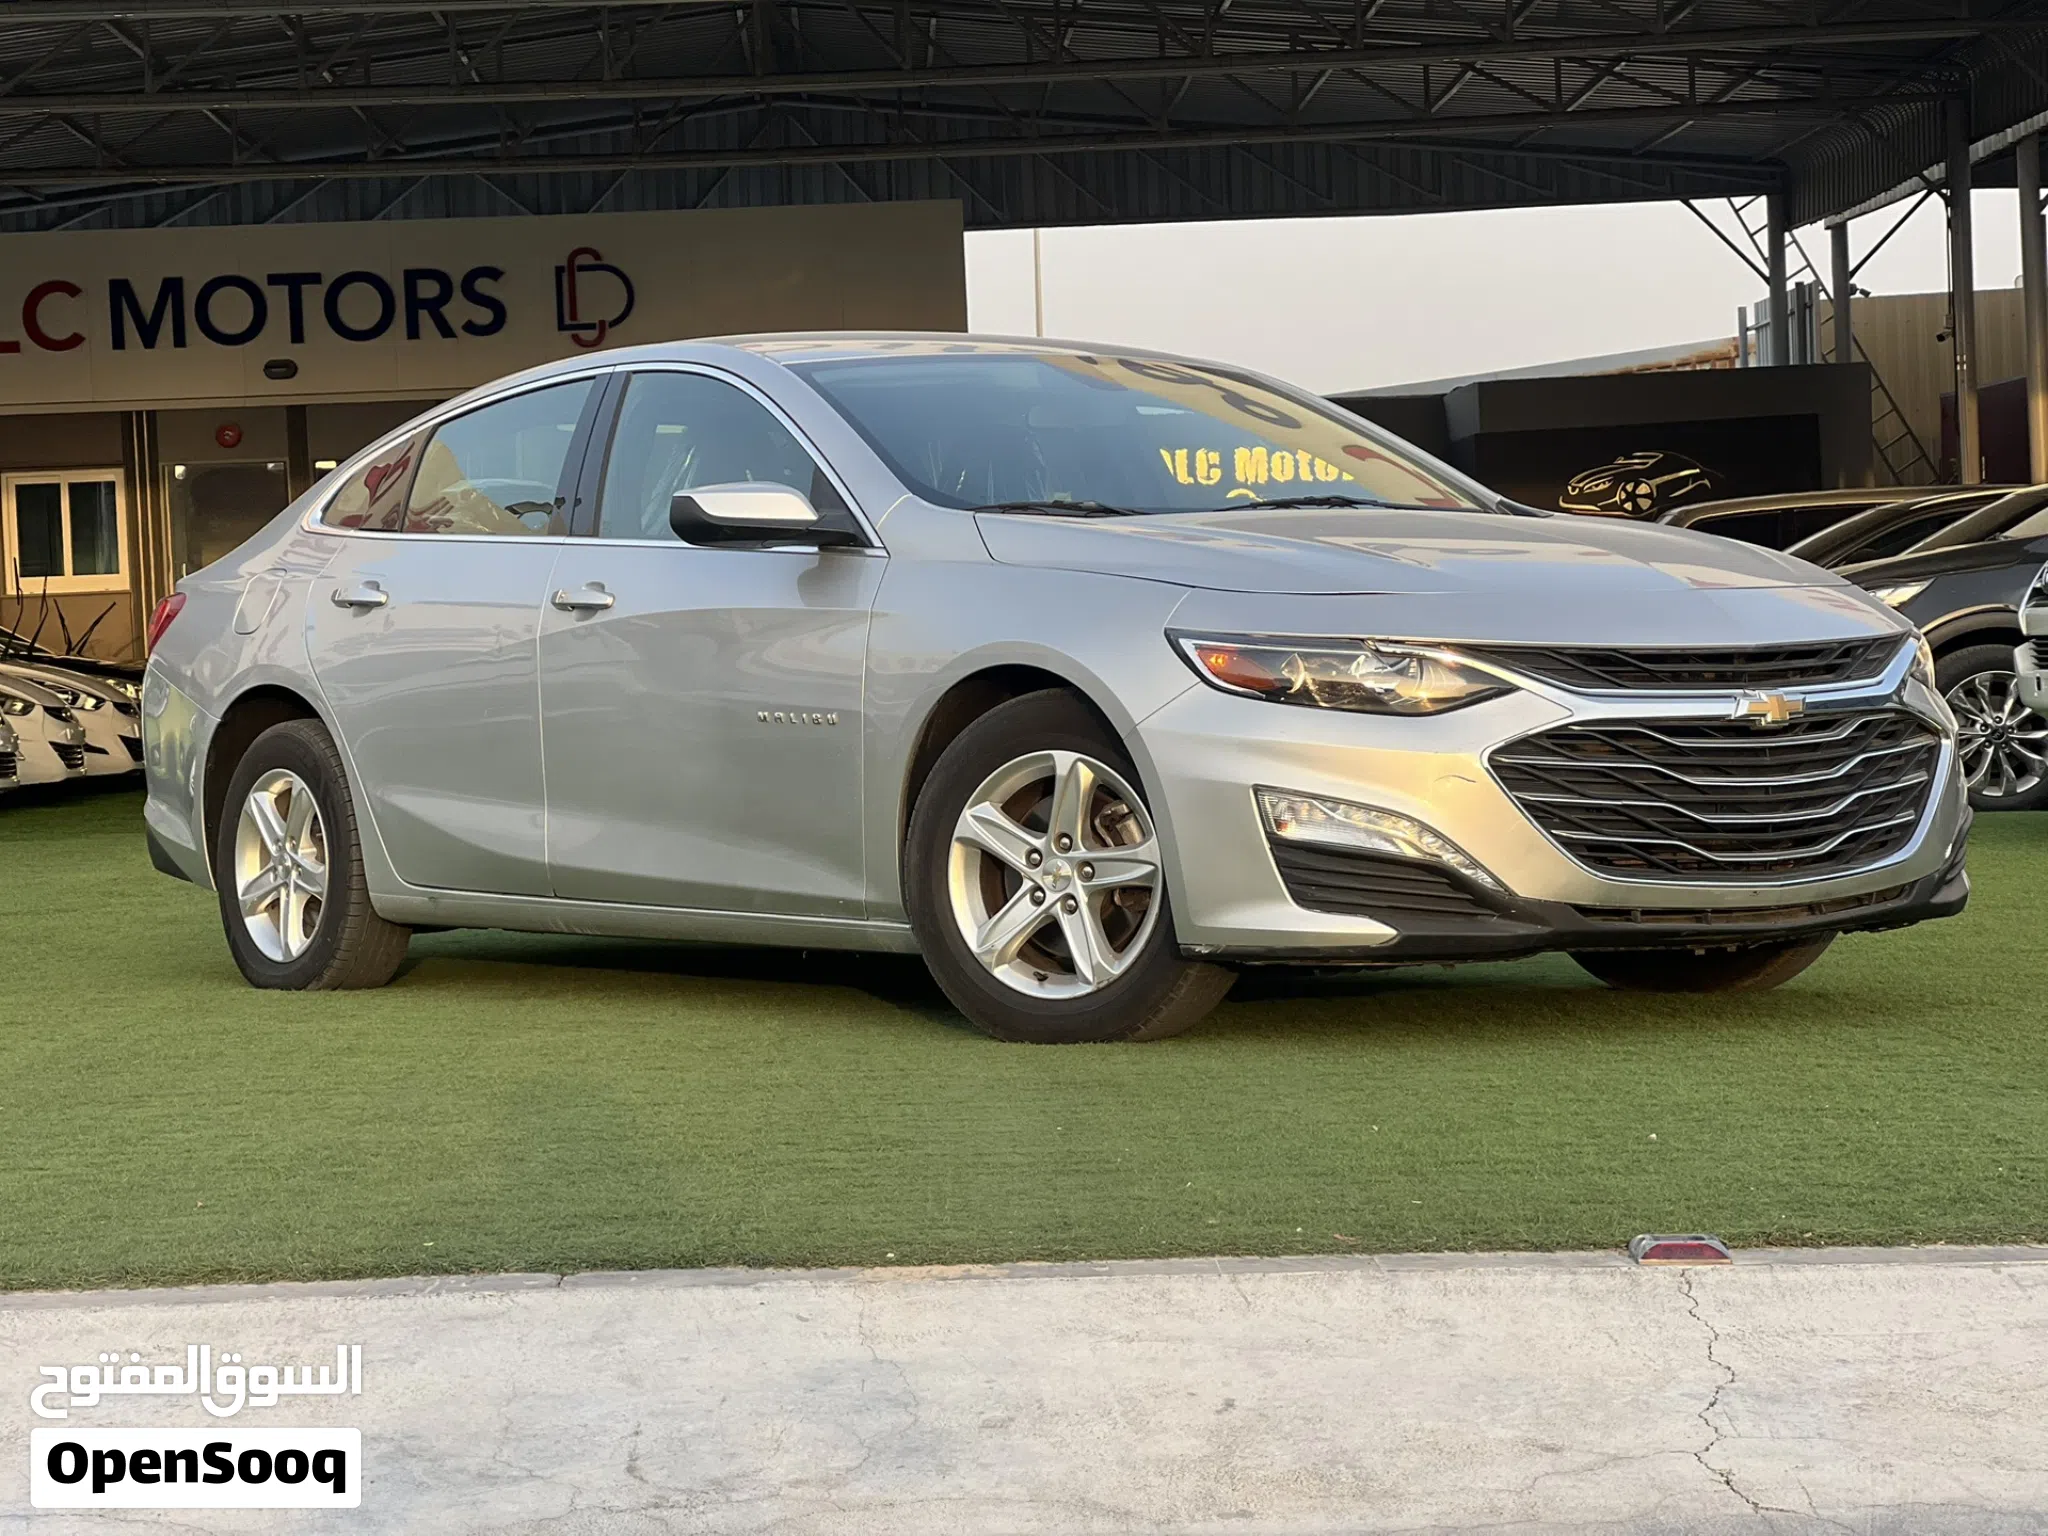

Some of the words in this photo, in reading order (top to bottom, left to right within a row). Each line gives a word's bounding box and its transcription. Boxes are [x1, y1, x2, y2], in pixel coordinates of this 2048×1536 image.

[108, 266, 507, 350] MOTORS
[1234, 446, 1354, 485] Moto
[757, 711, 839, 726] MALIBU
